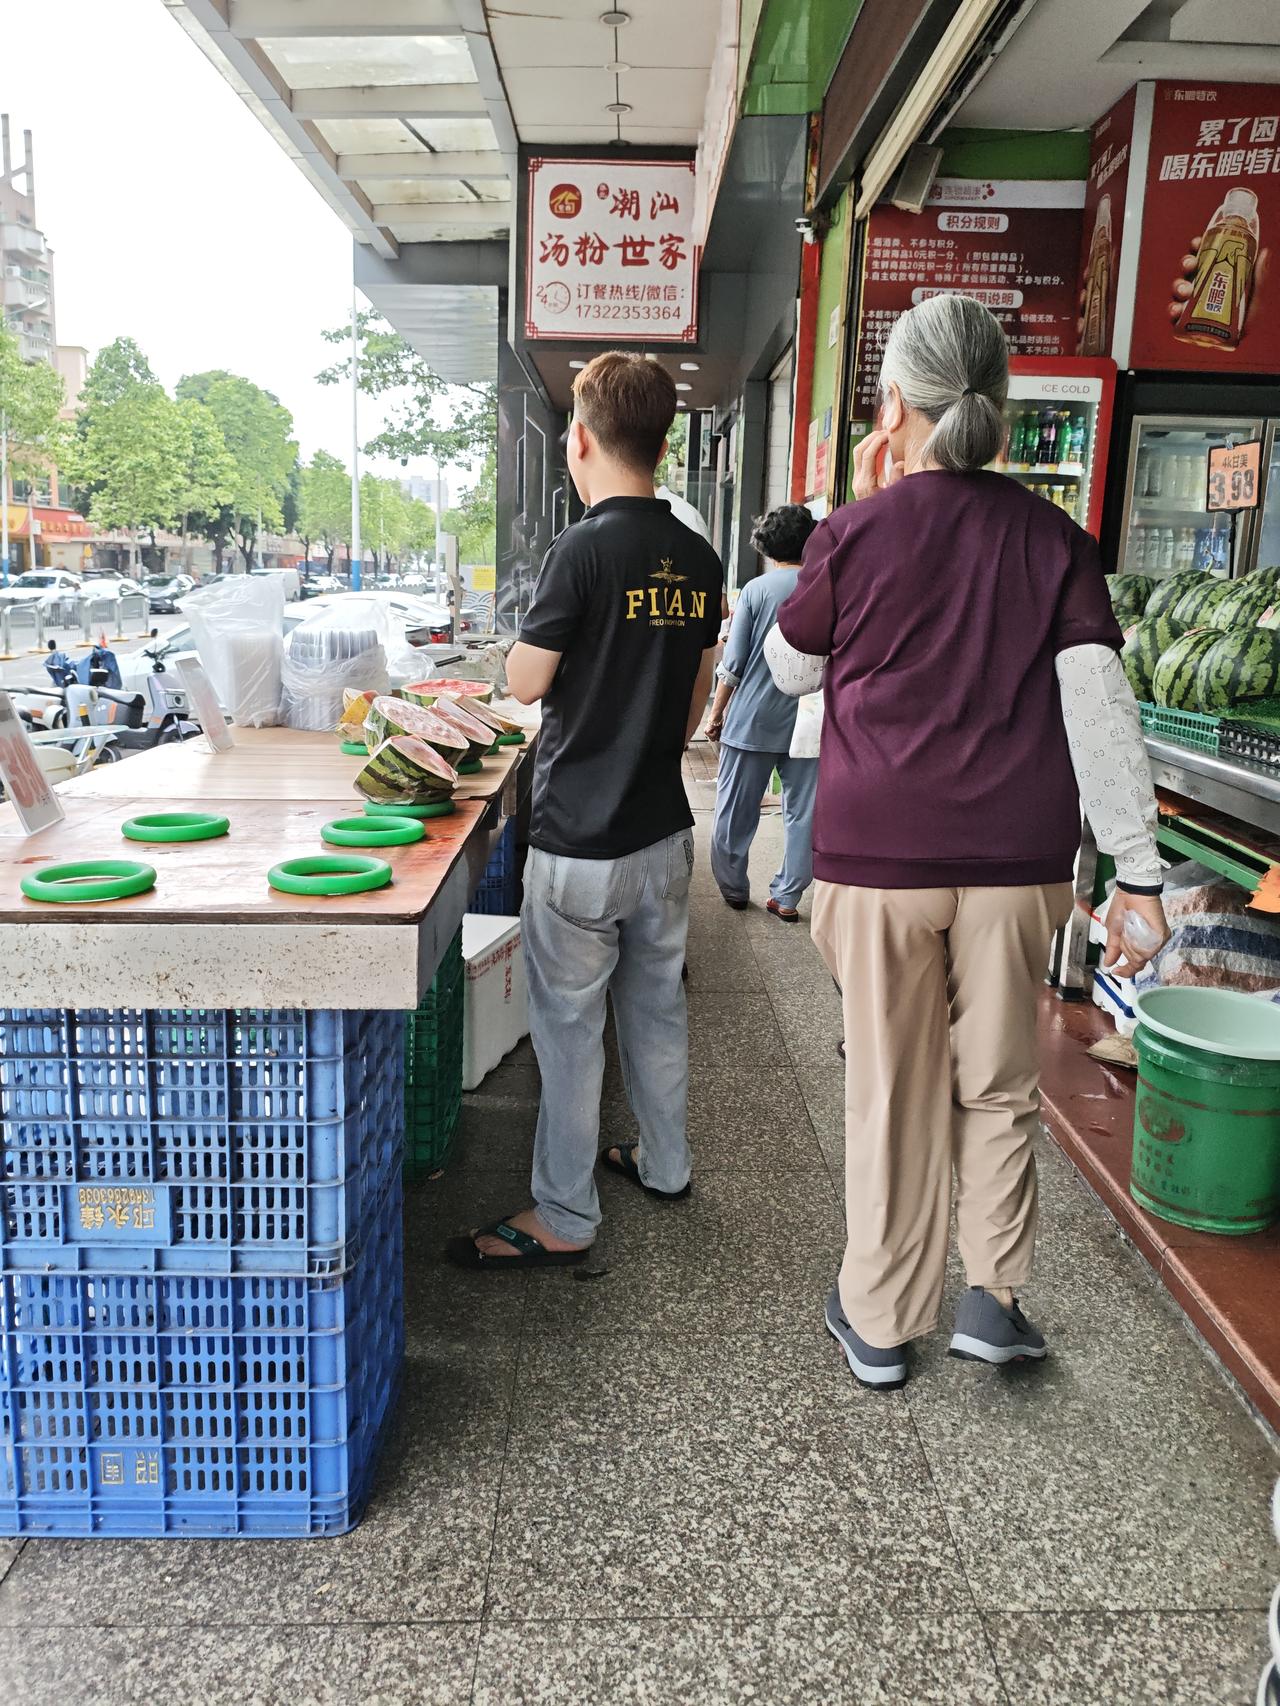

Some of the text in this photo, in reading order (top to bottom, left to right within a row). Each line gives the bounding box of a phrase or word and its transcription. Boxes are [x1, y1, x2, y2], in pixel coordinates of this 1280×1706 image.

[1196, 116, 1279, 146] 累了困
[610, 188, 679, 220] 潮汕
[946, 216, 1000, 230] 积分规则
[539, 232, 687, 270] 汤粉世家
[576, 304, 681, 320] 17322353364
[1041, 384, 1090, 394] ICE COLD
